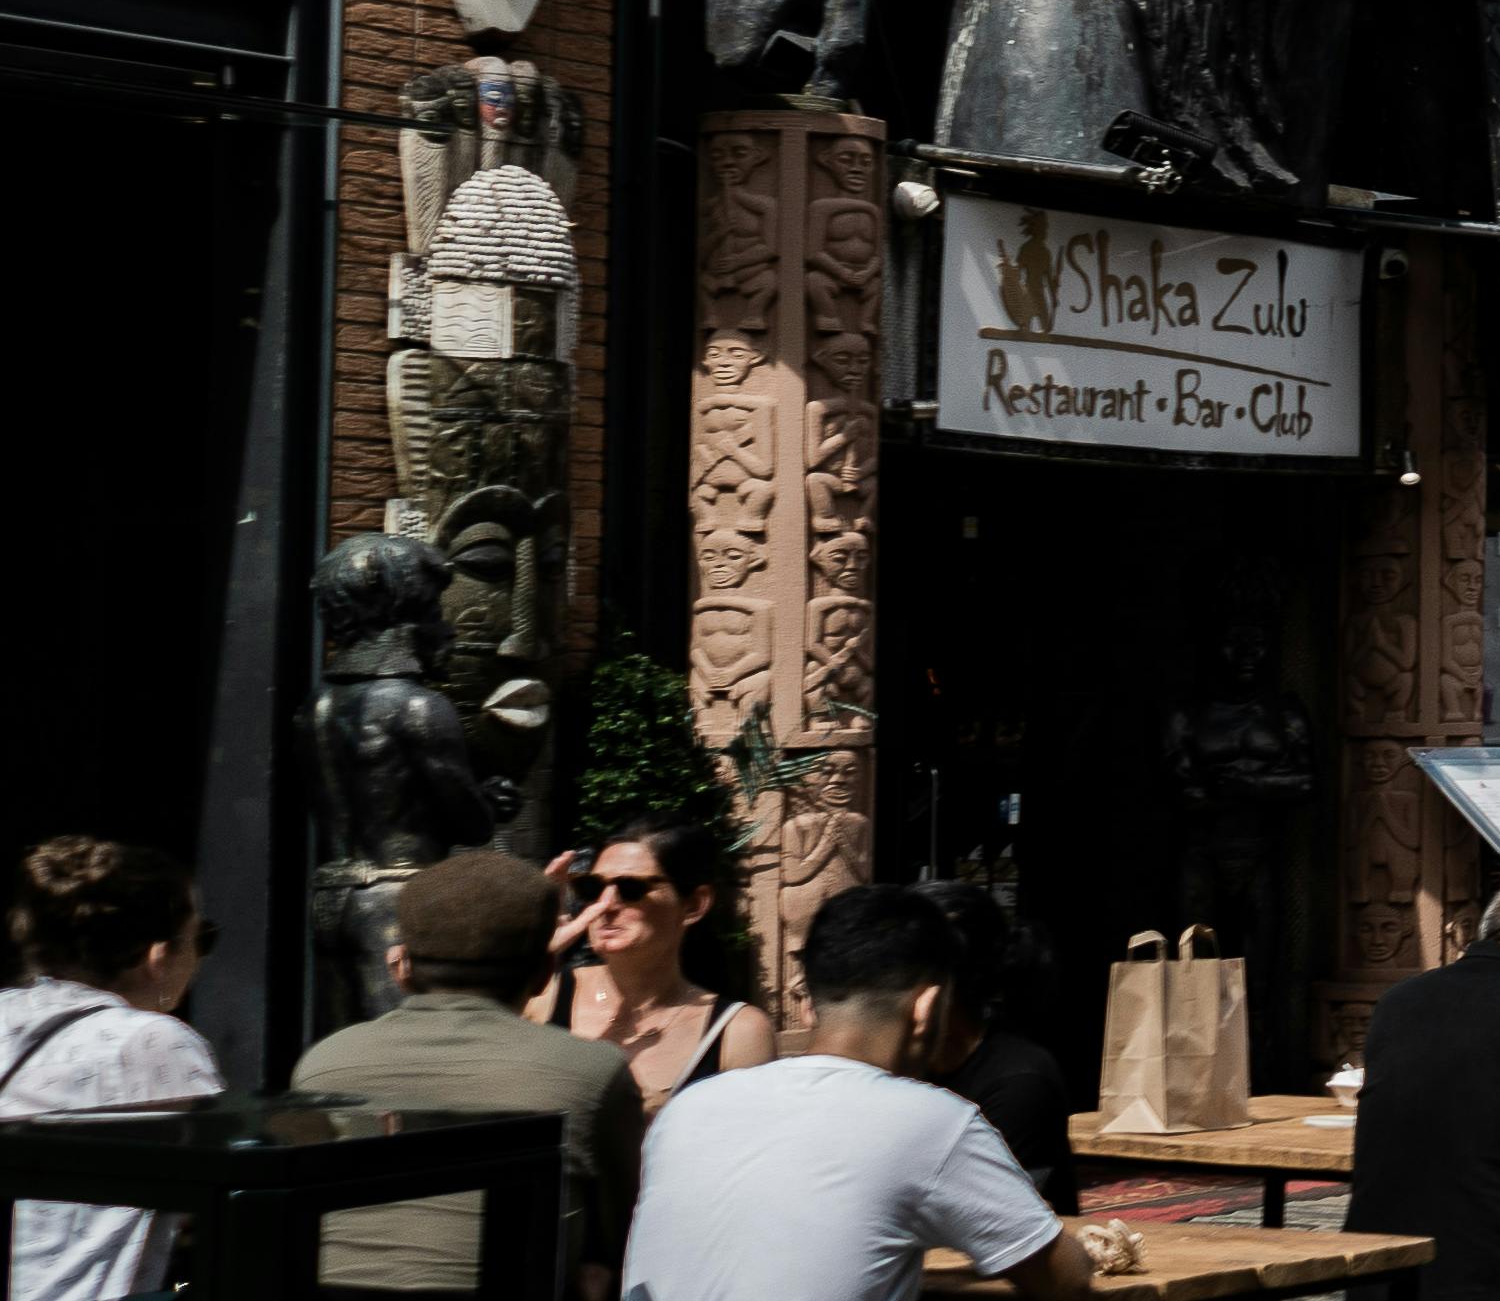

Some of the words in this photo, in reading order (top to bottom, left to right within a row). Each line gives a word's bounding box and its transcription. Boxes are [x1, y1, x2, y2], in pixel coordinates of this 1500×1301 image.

[1066, 229, 1200, 336] Shaka
[1211, 249, 1308, 339] Zulu
[982, 348, 1152, 423] Restaurant
[1173, 368, 1229, 429] Bar
[1250, 383, 1313, 441] Club
